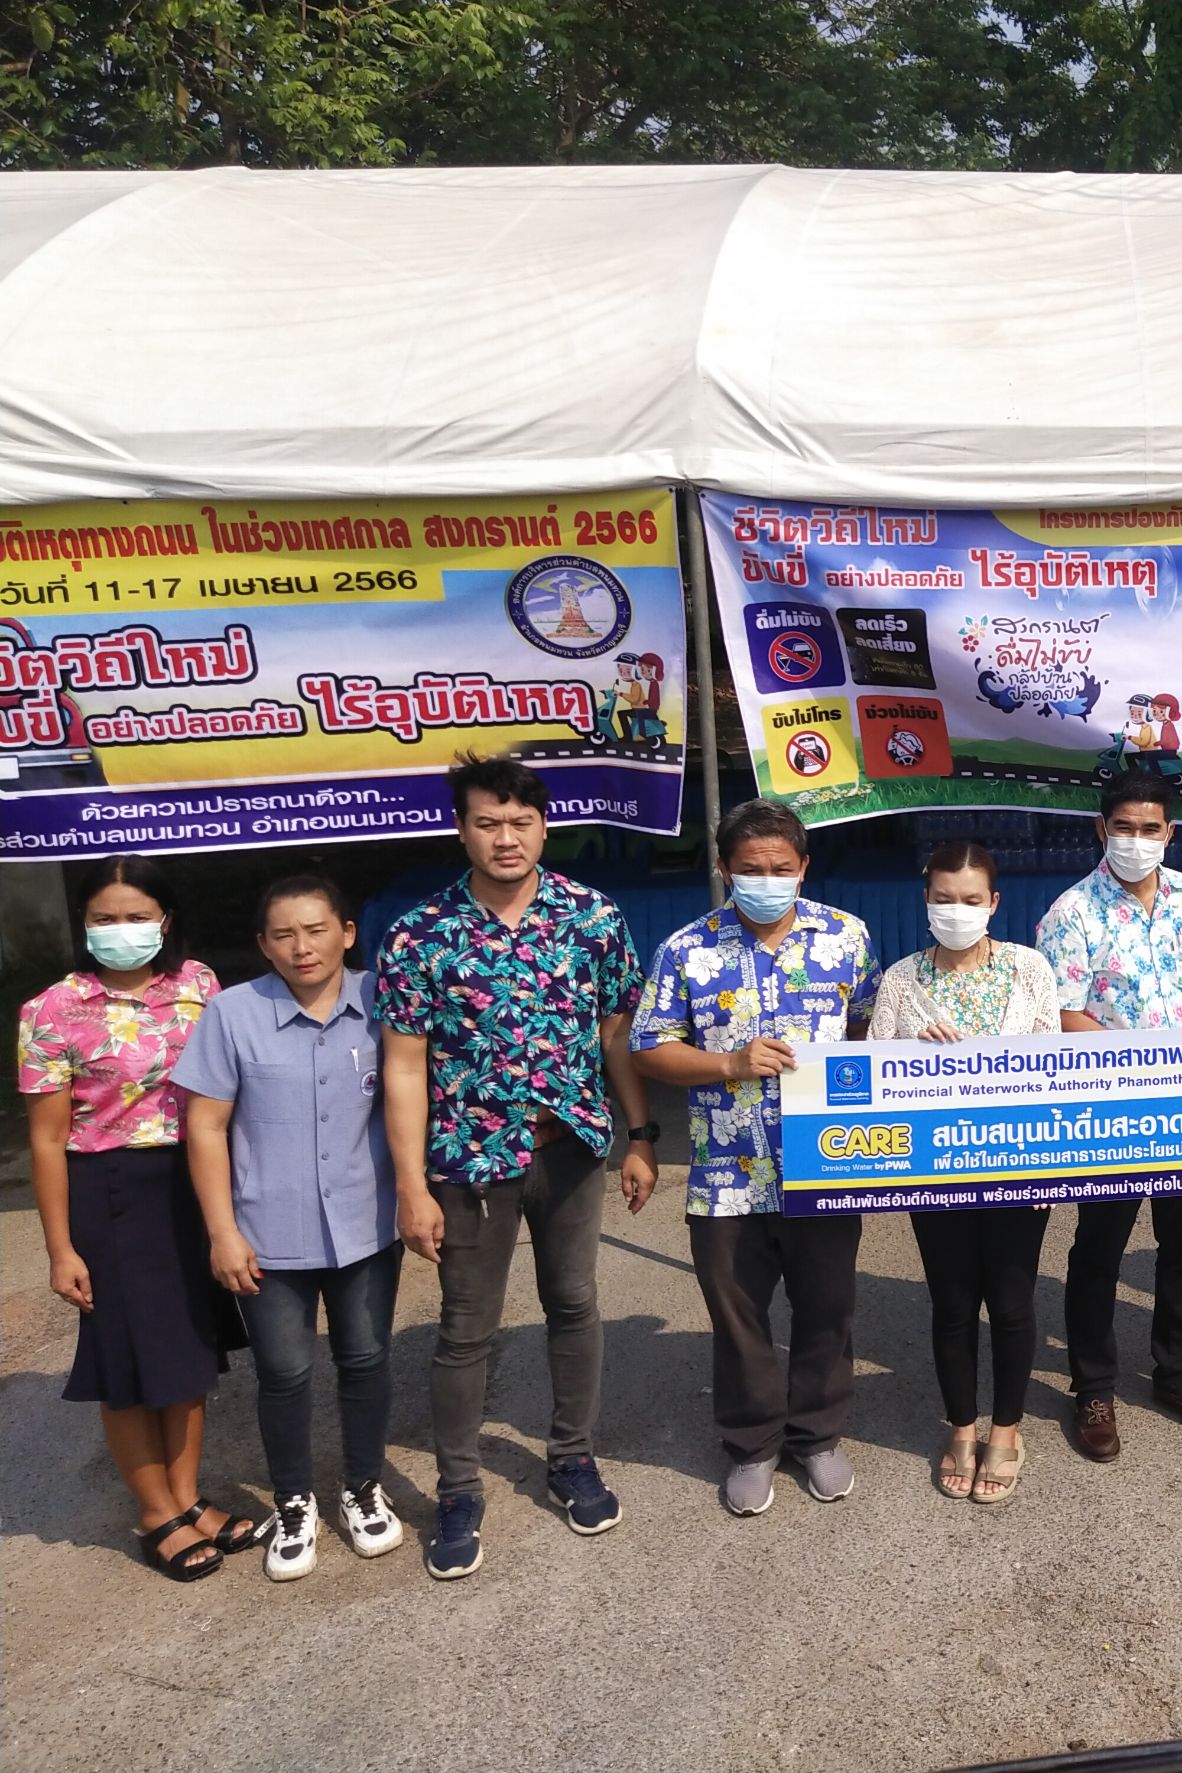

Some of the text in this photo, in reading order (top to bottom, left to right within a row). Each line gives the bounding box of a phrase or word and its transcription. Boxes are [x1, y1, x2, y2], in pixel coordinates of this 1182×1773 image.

[732, 505, 937, 544] ชีวิตวิถีใหม่
[0, 504, 657, 572] ติเหตุทางถนน ในช่วงเทศกาล สงกรานต์ 2566
[741, 544, 1157, 597] ขับขี่ อย่างปลอดภัย ไร้อุบัติเหตุ
[85, 578, 182, 602] 11-17
[200, 575, 318, 598] เมษายน
[333, 569, 418, 592] 2566
[756, 609, 821, 630] ดื่มไม่ขับ
[855, 614, 908, 632] ลดเร็ว
[991, 613, 1111, 634] สงกรานต์
[855, 633, 917, 653] ลดเสี่ยง
[995, 636, 1092, 671] ดื่มไม่ขับ
[90, 706, 299, 740] อย่างปลอดภัย
[305, 678, 592, 736] ไร้อุบัติเหตุ
[772, 705, 842, 729] ขับไม่โทร
[865, 703, 939, 720] ง่วงไม่ขับ
[82, 787, 405, 821] ด้วยความปรารถนาดีจาก...
[252, 807, 442, 834] อำเภอพนมทวน
[882, 1086, 952, 1099] Provincial
[959, 1082, 1042, 1096] Waterworks
[1048, 1078, 1112, 1092] Authority
[820, 1125, 910, 1157] CARE
[821, 1164, 850, 1173] Drinking
[852, 1163, 873, 1171] Water
[816, 1190, 976, 1210] สานสัมพันธ์อันดีกับชุมชน
